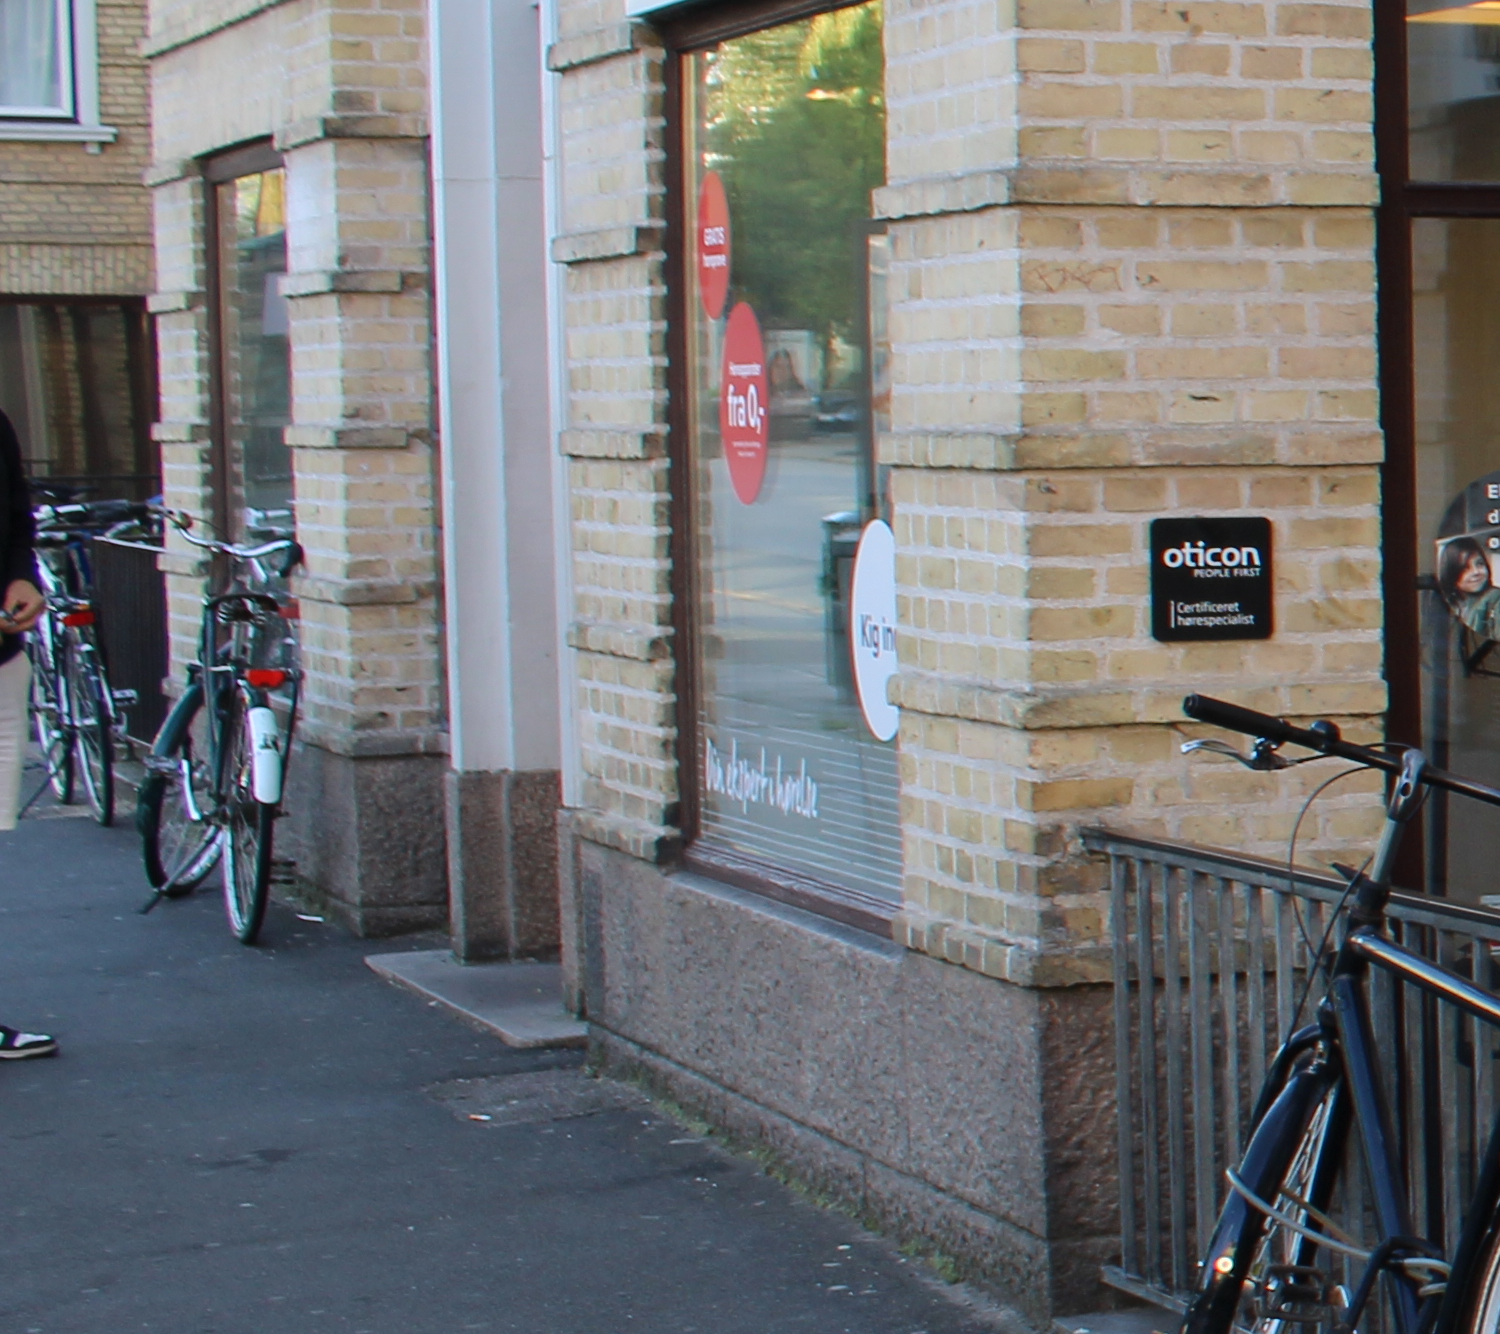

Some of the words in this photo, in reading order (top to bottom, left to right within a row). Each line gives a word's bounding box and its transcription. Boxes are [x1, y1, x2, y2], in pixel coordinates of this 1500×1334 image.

[728, 384, 746, 427] fra
[1162, 540, 1261, 568] oticon
[1194, 568, 1231, 578] PEOPLE
[1233, 568, 1261, 577] FIRST
[1177, 601, 1240, 613] Certificeret
[1177, 614, 1255, 627] hørespecialist
[861, 613, 882, 658] Kig
